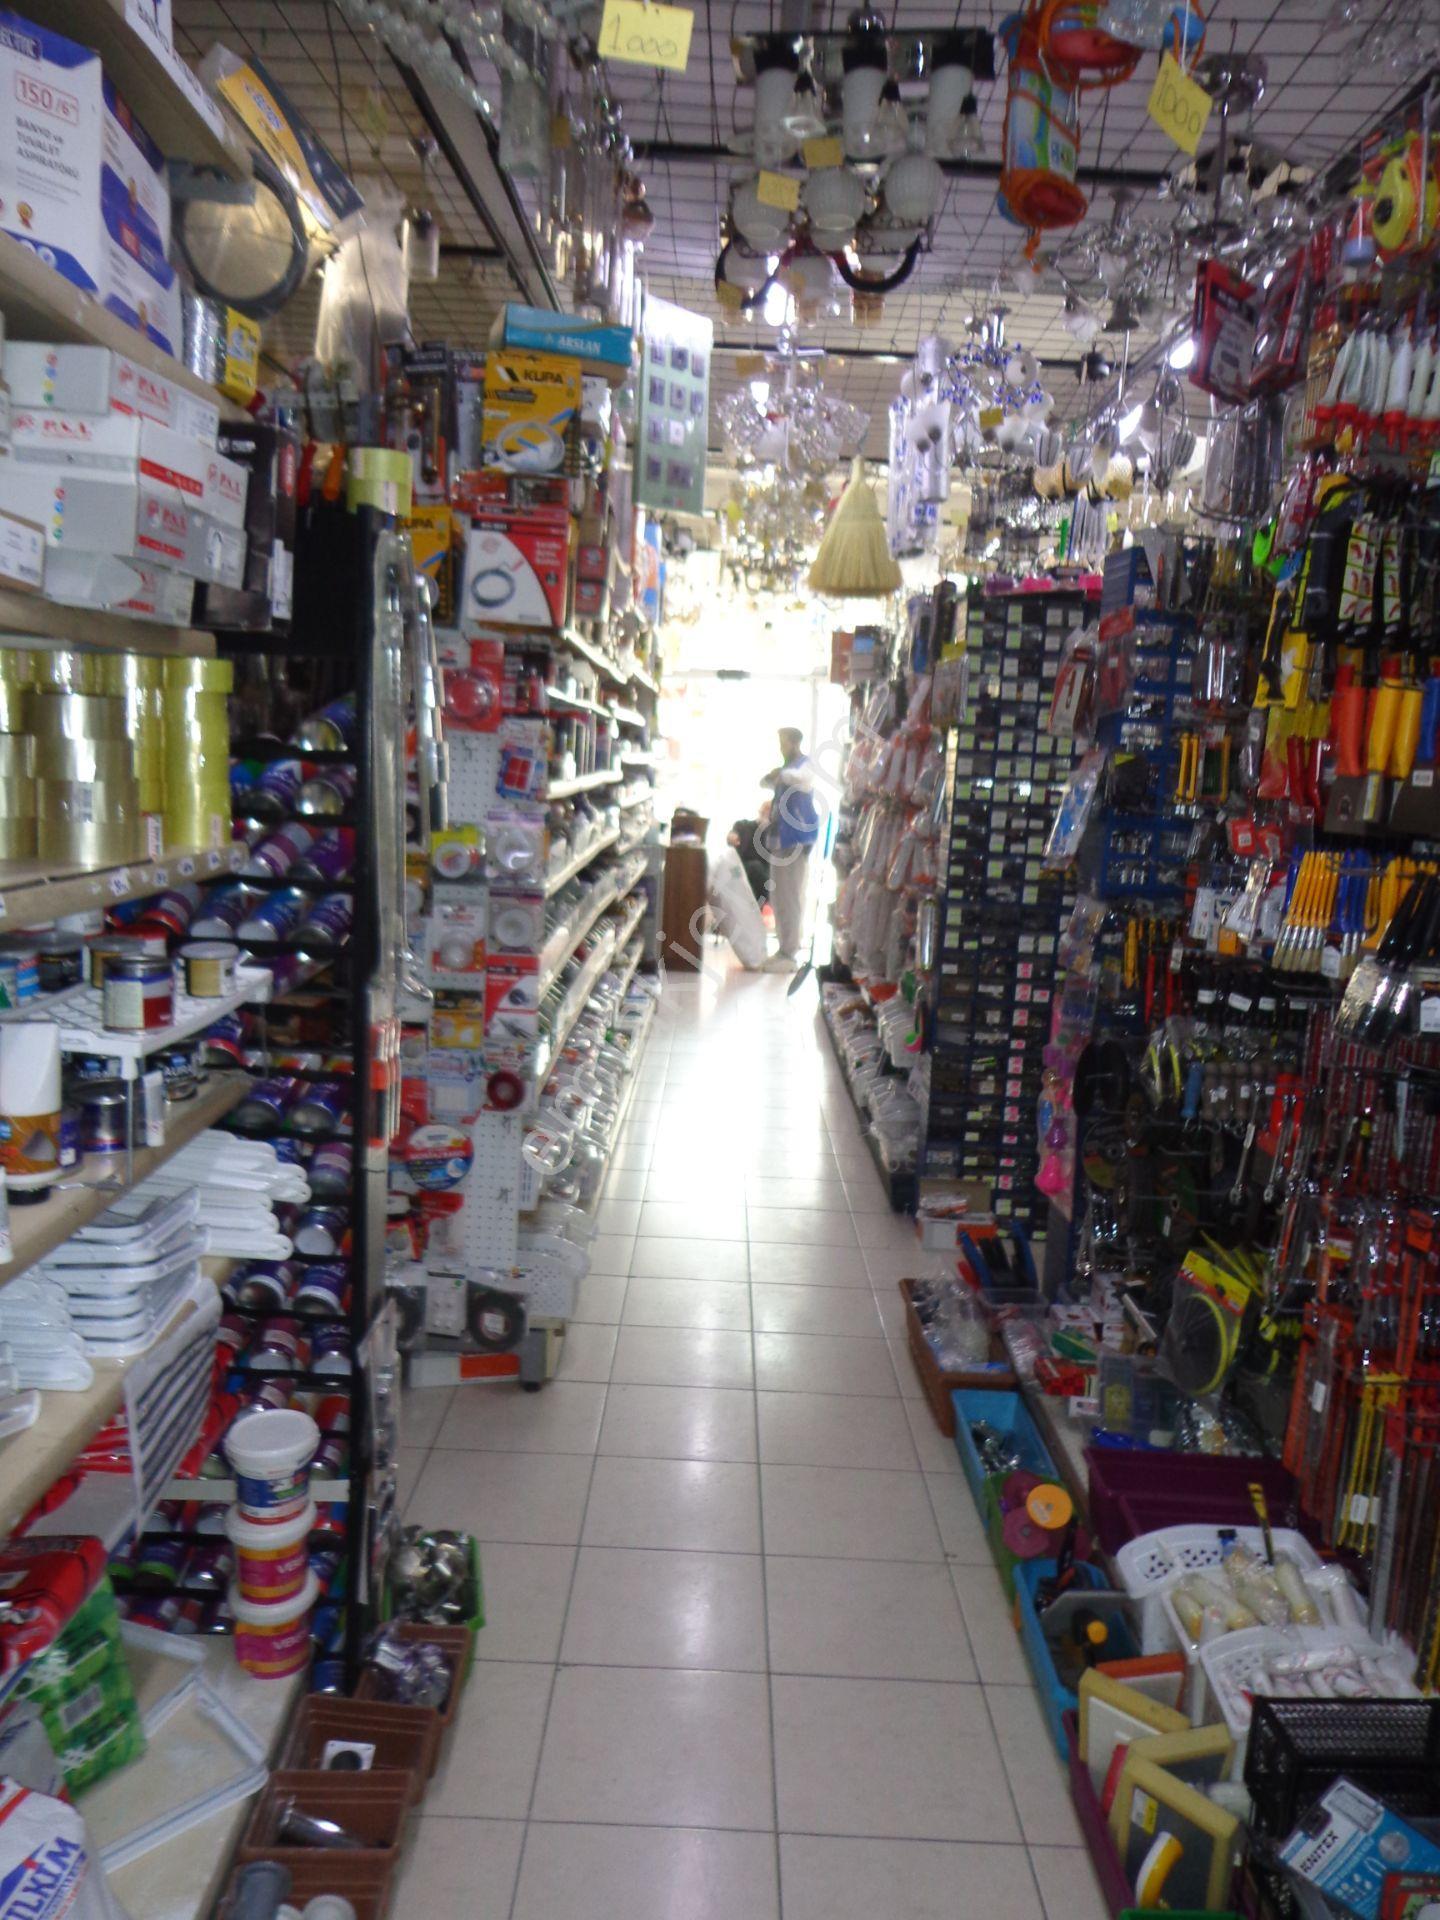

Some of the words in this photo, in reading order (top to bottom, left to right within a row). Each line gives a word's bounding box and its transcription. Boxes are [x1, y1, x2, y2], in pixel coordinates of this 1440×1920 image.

[20, 78, 53, 110] 150
[1156, 68, 1201, 135] 1000
[557, 335, 601, 353] ARSLAN
[524, 368, 564, 385] KUPA
[1299, 1829, 1340, 1874] KNITEX
